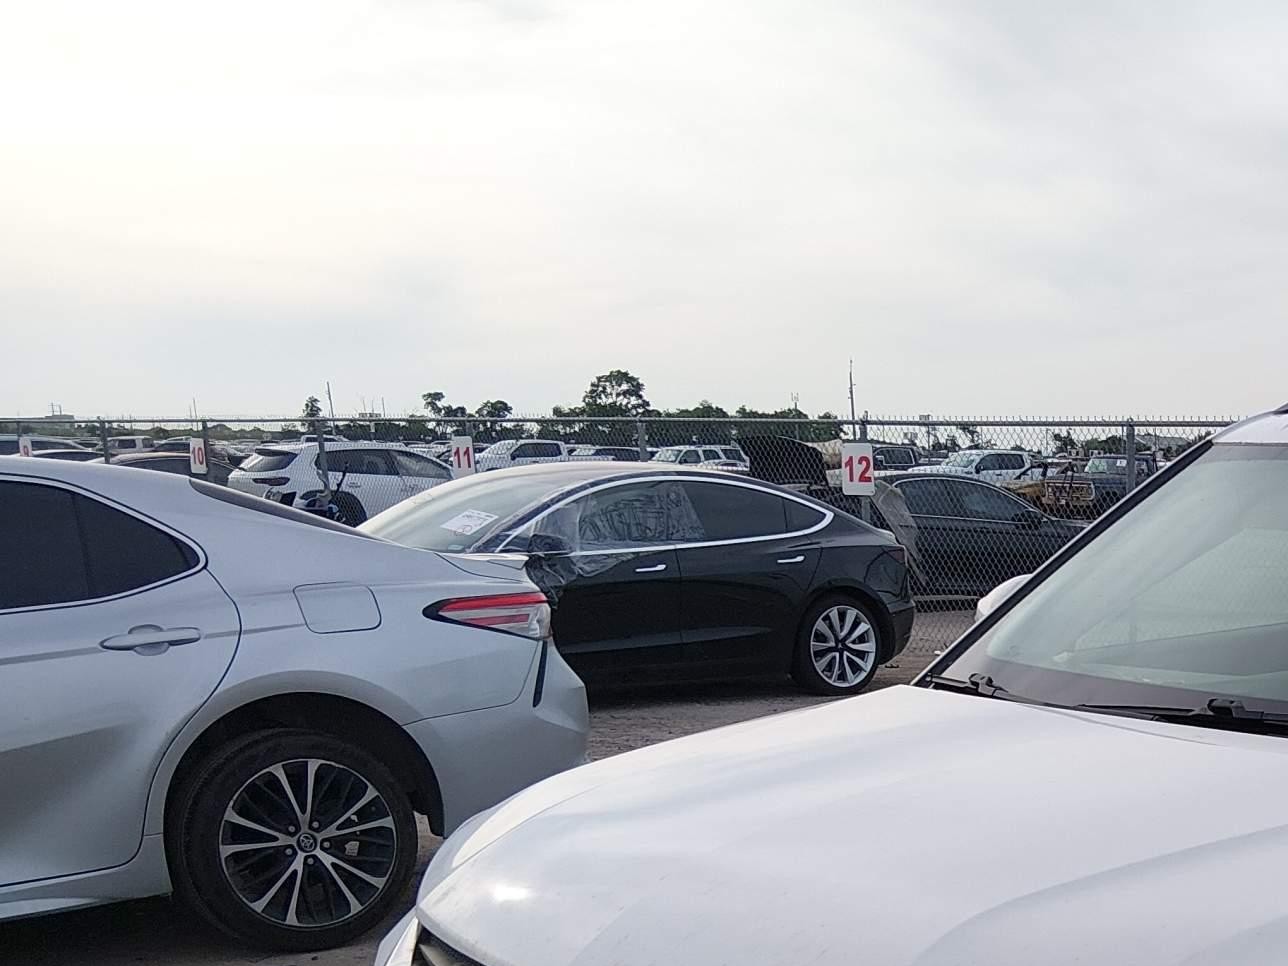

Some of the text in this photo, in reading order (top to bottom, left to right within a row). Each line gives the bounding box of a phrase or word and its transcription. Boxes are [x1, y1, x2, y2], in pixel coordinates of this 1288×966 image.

[192, 446, 204, 465] 10
[453, 446, 473, 469] 11
[844, 455, 873, 483] 12
